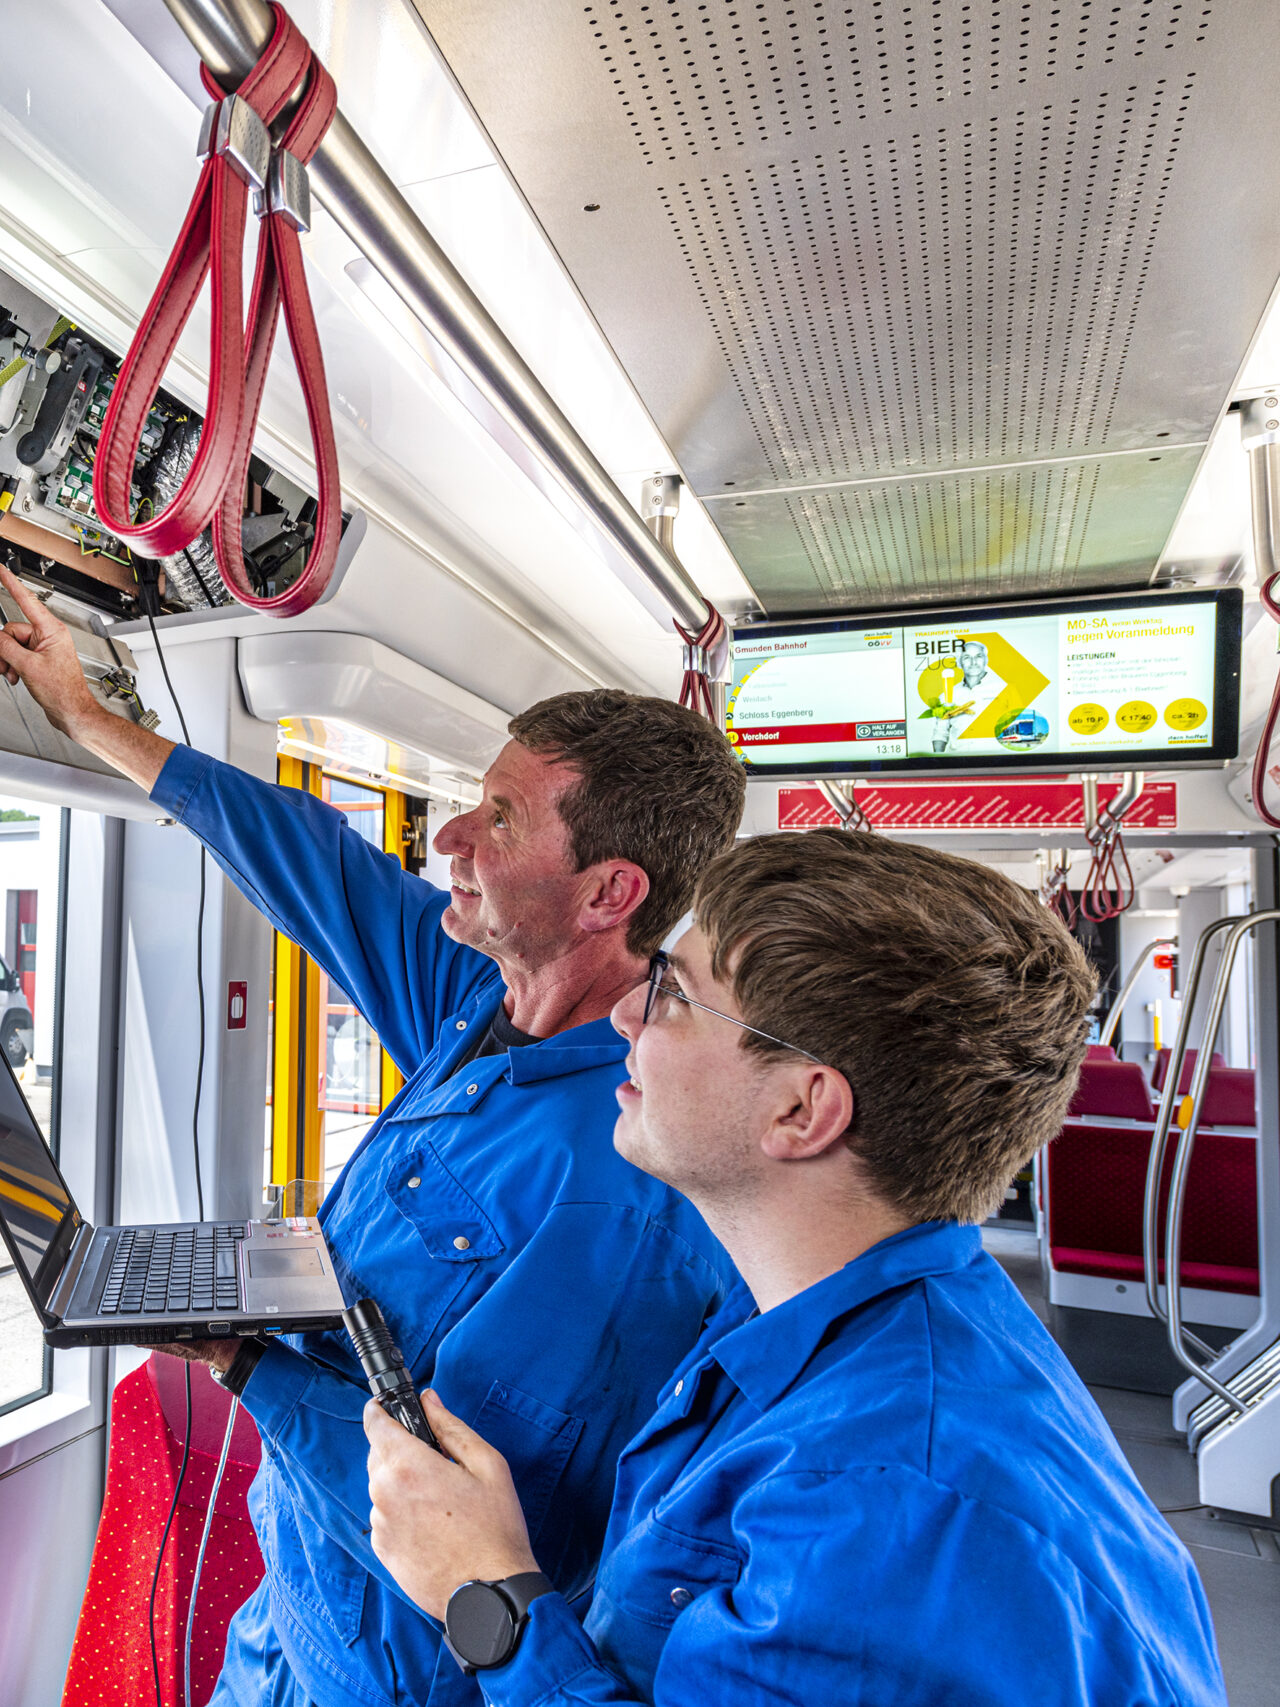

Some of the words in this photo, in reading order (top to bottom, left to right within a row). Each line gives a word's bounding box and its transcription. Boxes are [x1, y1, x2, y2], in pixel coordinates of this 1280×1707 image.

[1067, 617, 1108, 630] MO-SA
[1067, 632, 1103, 644] gegen
[1106, 625, 1195, 640] Voranmeldung
[735, 644, 772, 654] Gmunden
[774, 641, 807, 651] Bahnhof
[915, 639, 966, 655] BIER
[1067, 651, 1116, 661] LEISTUNGEN
[914, 655, 958, 671] ZUG
[739, 711, 769, 720] Schloss
[771, 709, 813, 719] Eggenberg
[742, 731, 780, 741] Vorchdorf
[872, 729, 905, 737] VERLANGEN
[876, 744, 901, 754] 13:18
